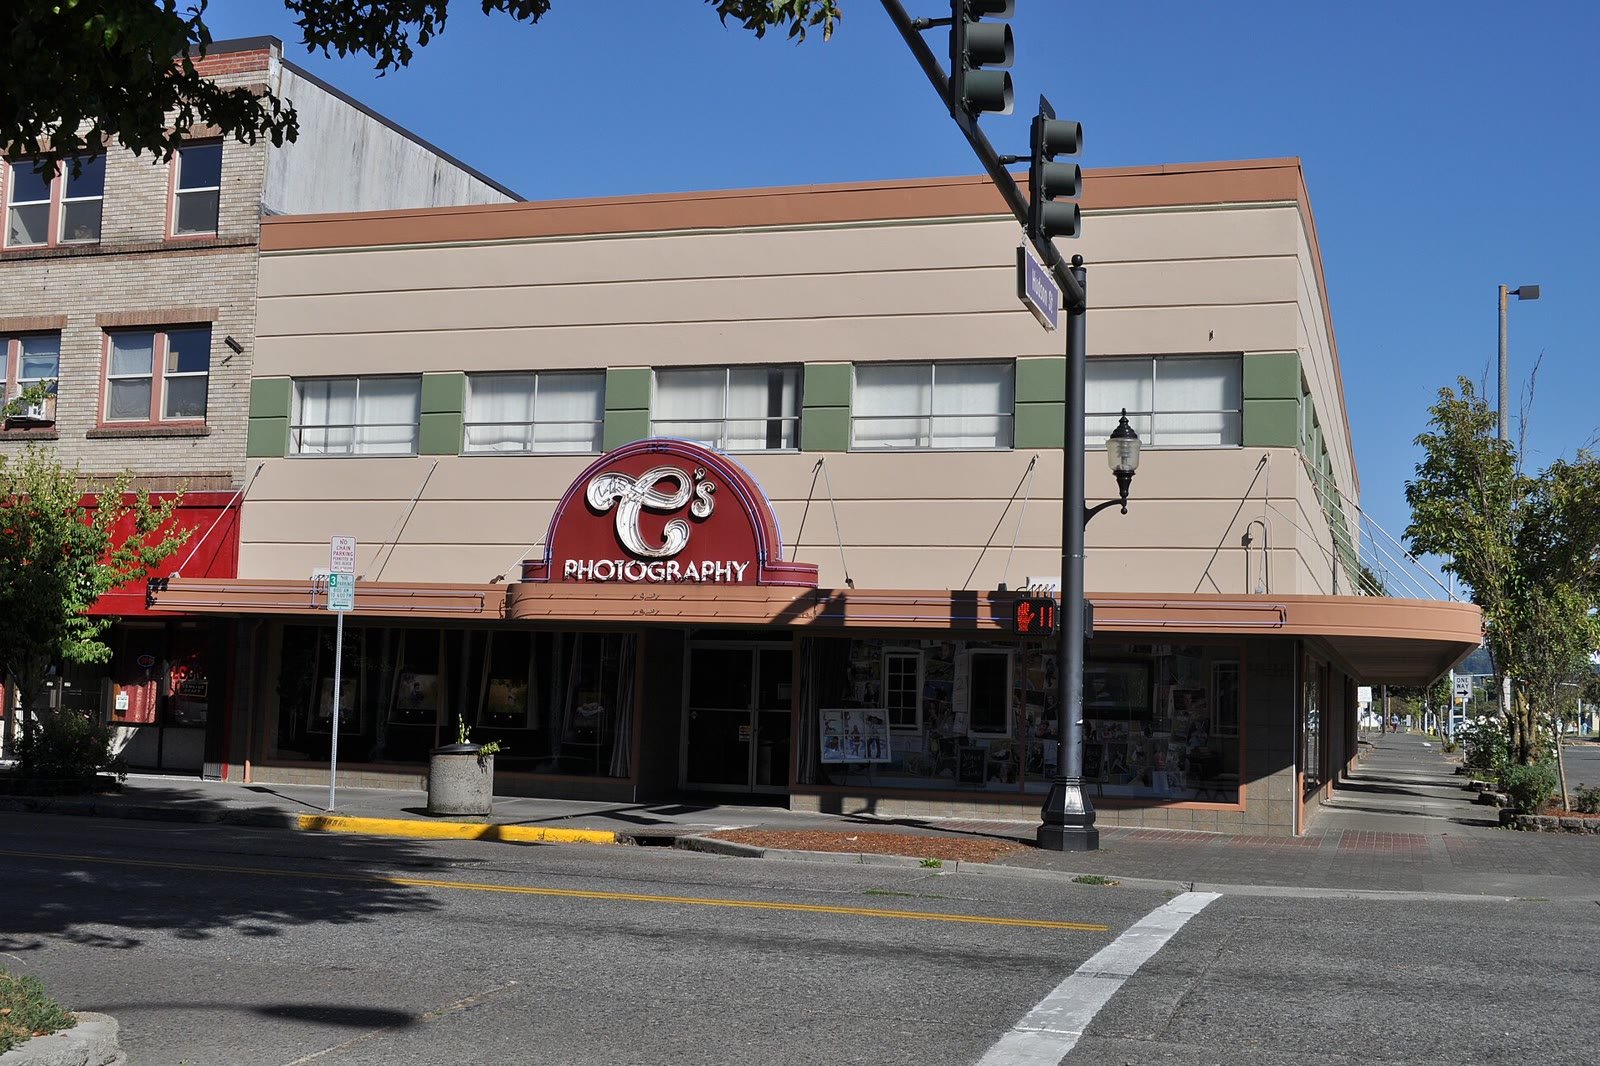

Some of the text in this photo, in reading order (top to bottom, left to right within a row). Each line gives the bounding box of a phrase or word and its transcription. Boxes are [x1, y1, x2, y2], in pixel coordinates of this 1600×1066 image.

[586, 465, 716, 558] C's
[331, 576, 336, 585] 3
[564, 559, 749, 582] PHOTOGRAPHY
[1040, 606, 1053, 628] 11
